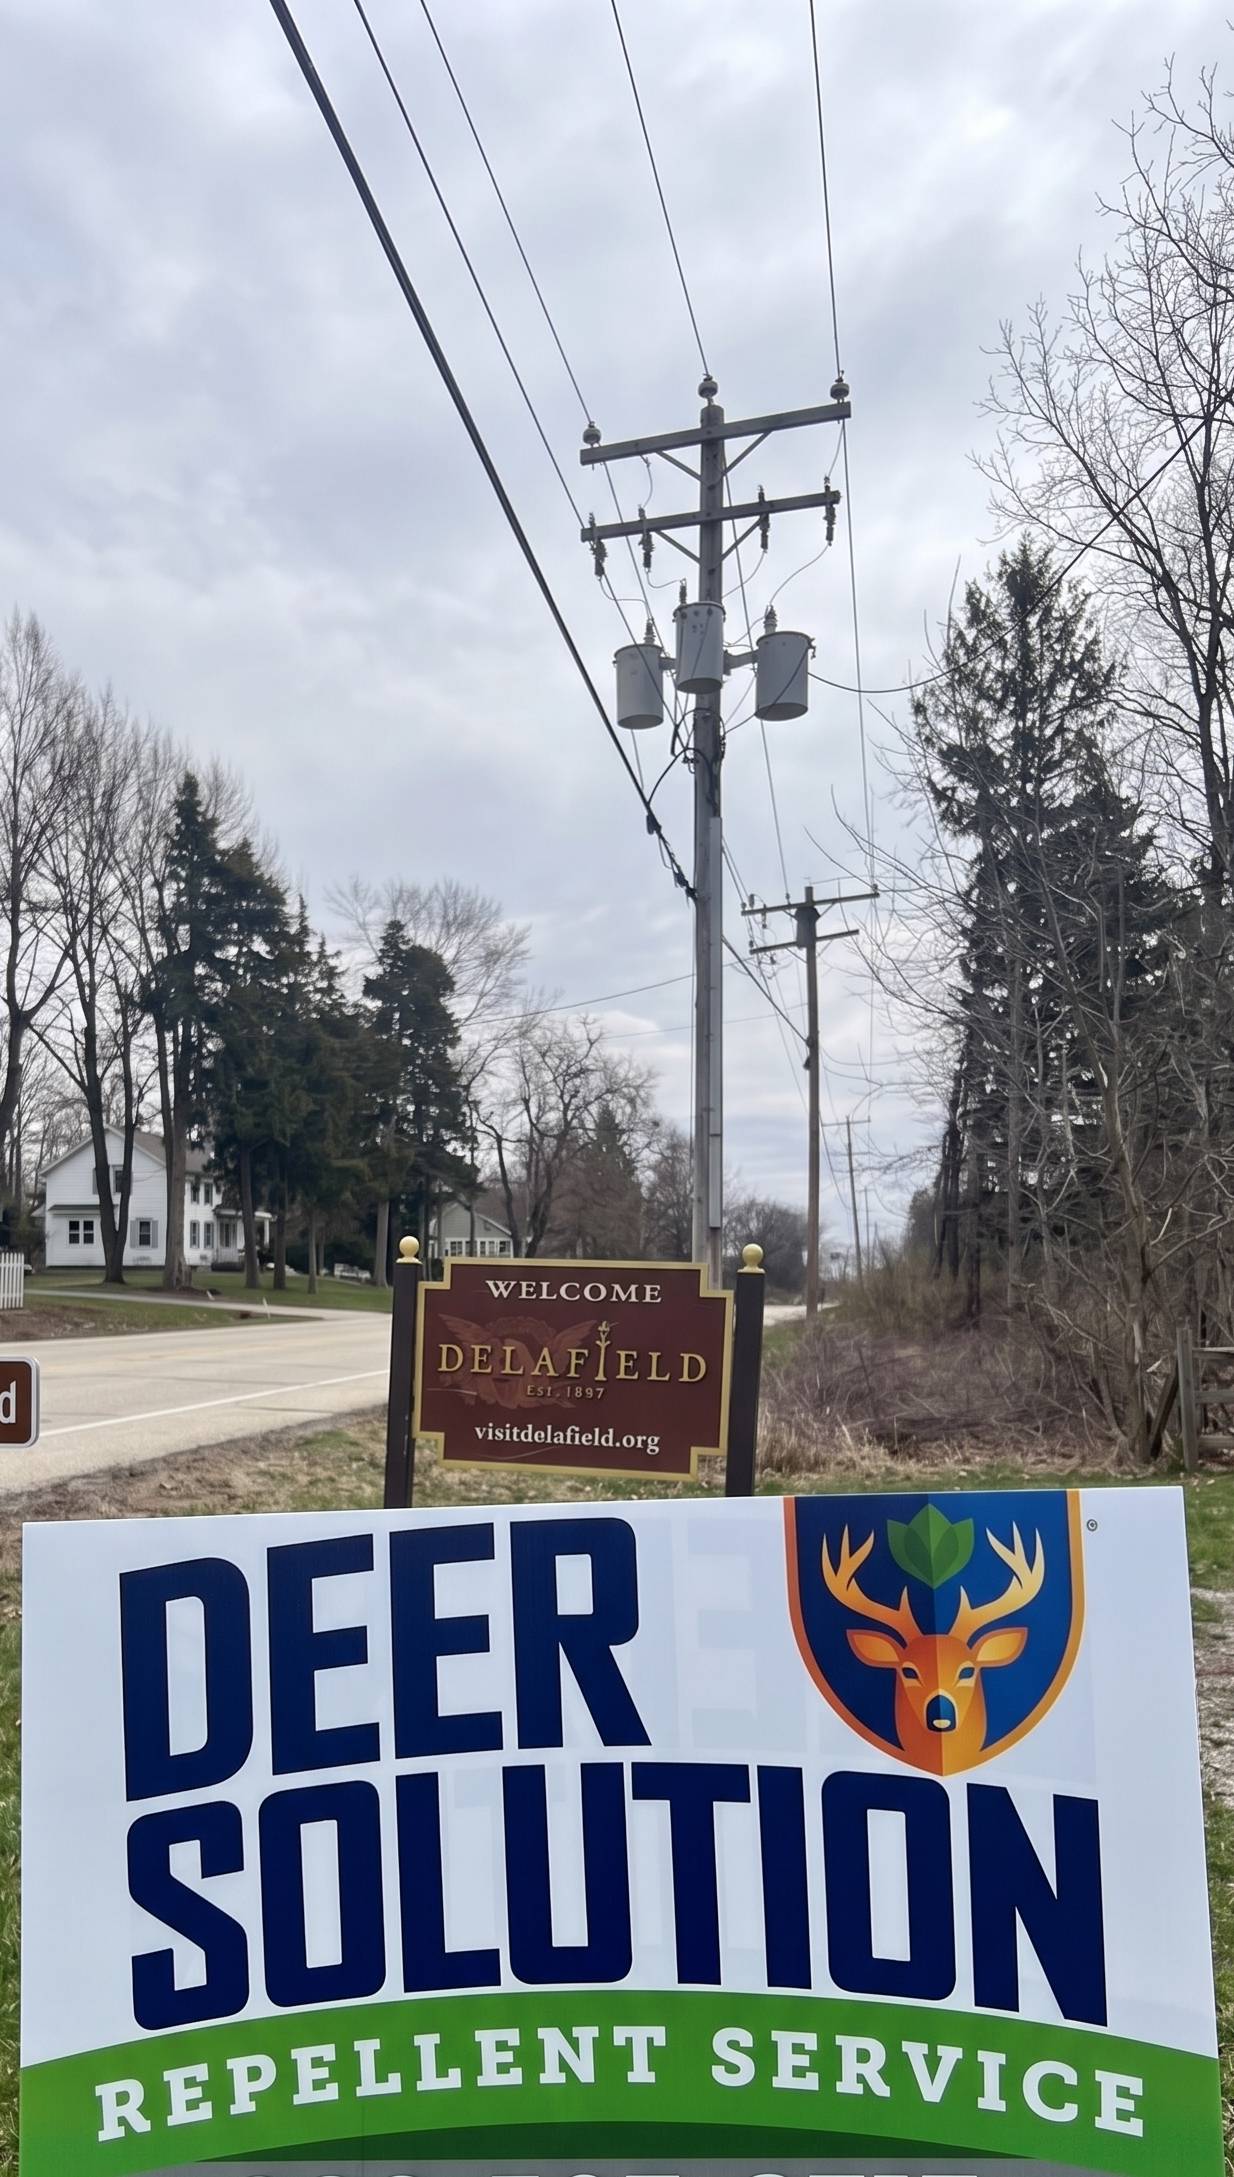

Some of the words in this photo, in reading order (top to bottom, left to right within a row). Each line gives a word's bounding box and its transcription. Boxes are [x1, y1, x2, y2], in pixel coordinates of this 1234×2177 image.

[485, 1279, 663, 1304] WELCOME
[437, 1335, 707, 1383] DELAFIELD
[566, 1386, 605, 1400] 1897
[474, 1422, 660, 1455] visitdelafield.org
[119, 1517, 651, 1801] DEER
[126, 1762, 1109, 2031] SOLUTION
[95, 2026, 667, 2143] REPELLENT
[711, 2027, 1145, 2137] SERVICE
